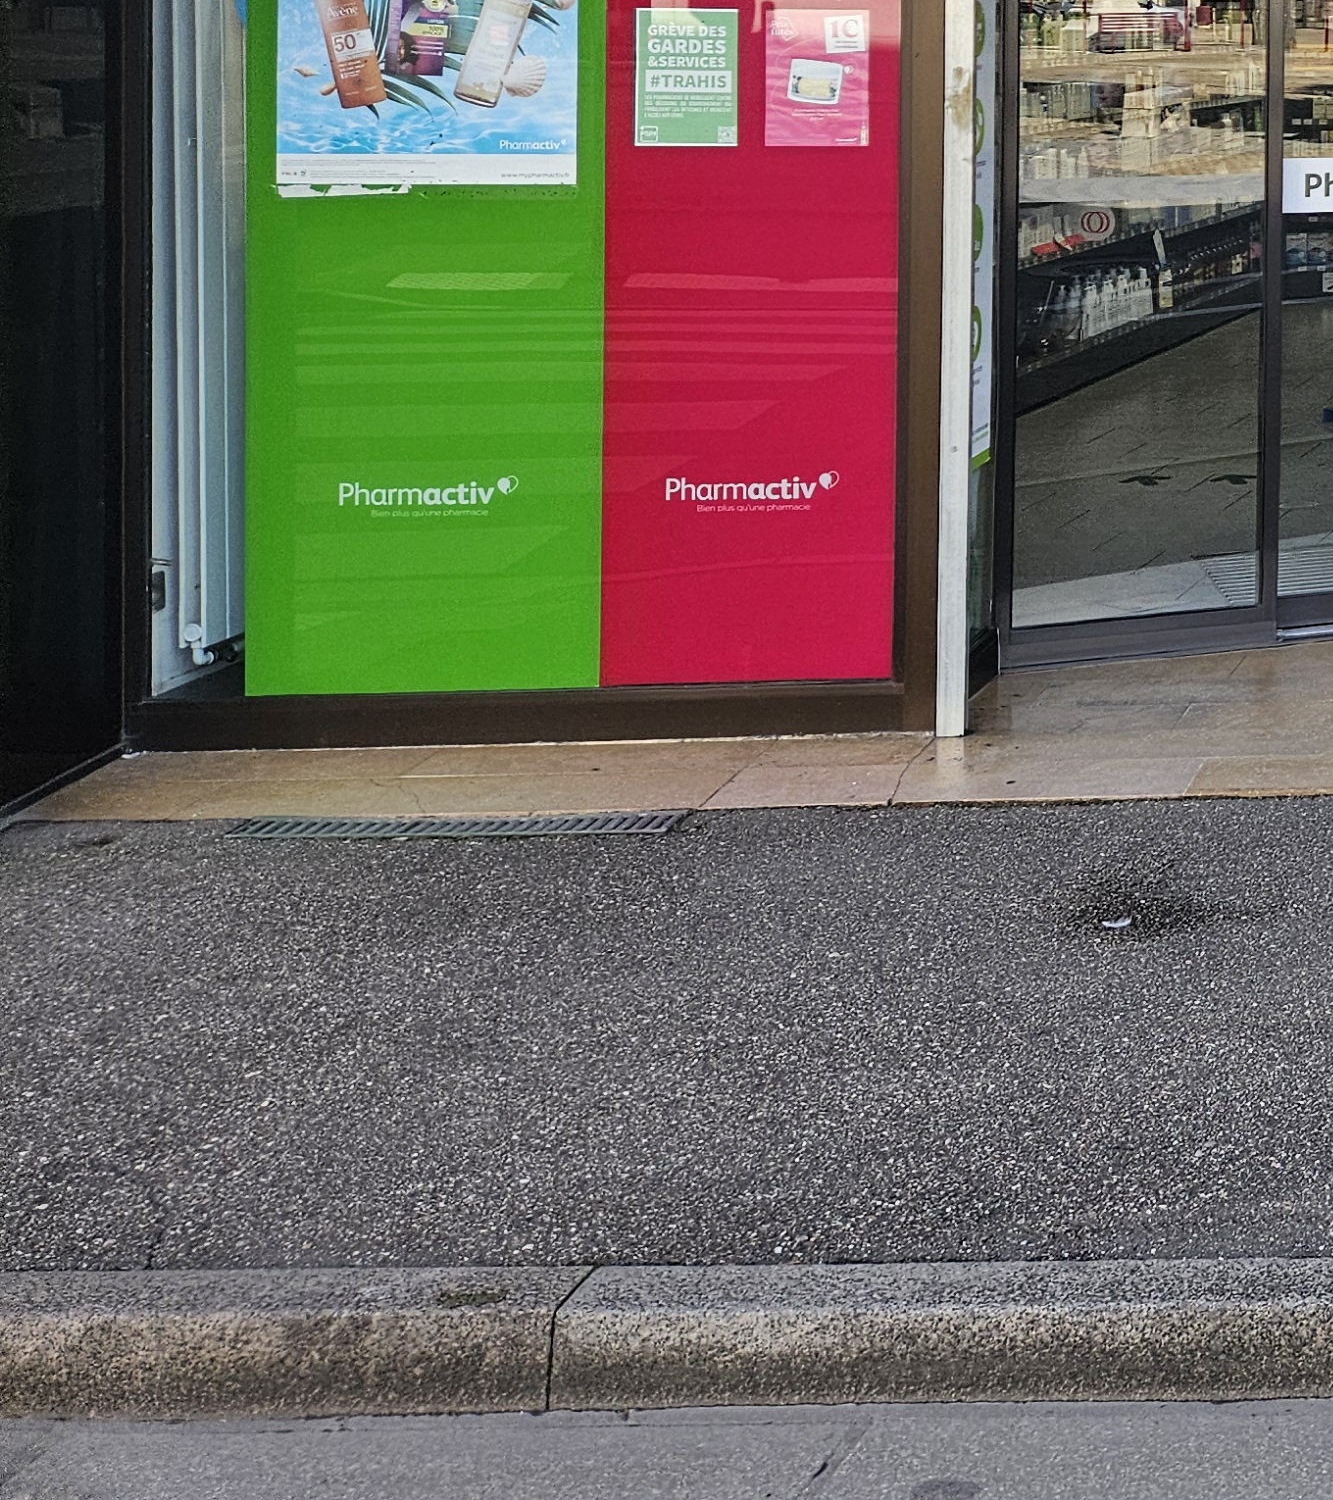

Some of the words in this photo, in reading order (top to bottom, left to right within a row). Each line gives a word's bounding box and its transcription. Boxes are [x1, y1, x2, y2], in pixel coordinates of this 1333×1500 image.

[648, 21, 695, 36] GRÈVE
[699, 26, 726, 37] DES
[829, 19, 858, 38] 1€
[334, 33, 357, 52] 50
[648, 39, 726, 54] GARDES
[648, 56, 726, 68] &SERVICES
[651, 75, 727, 88] #TRAHIS
[500, 139, 560, 150] Pharmactiv
[338, 481, 495, 506] Pharmactiv
[665, 476, 817, 501] Pharmactiv
[371, 509, 390, 517] Bien
[392, 509, 410, 518] plus
[412, 509, 441, 518] qu'une
[443, 509, 489, 517] pharmacie
[697, 504, 716, 512] Bien
[717, 504, 735, 512] plus
[737, 504, 765, 512] qu'une
[766, 503, 811, 512] pharmacie
